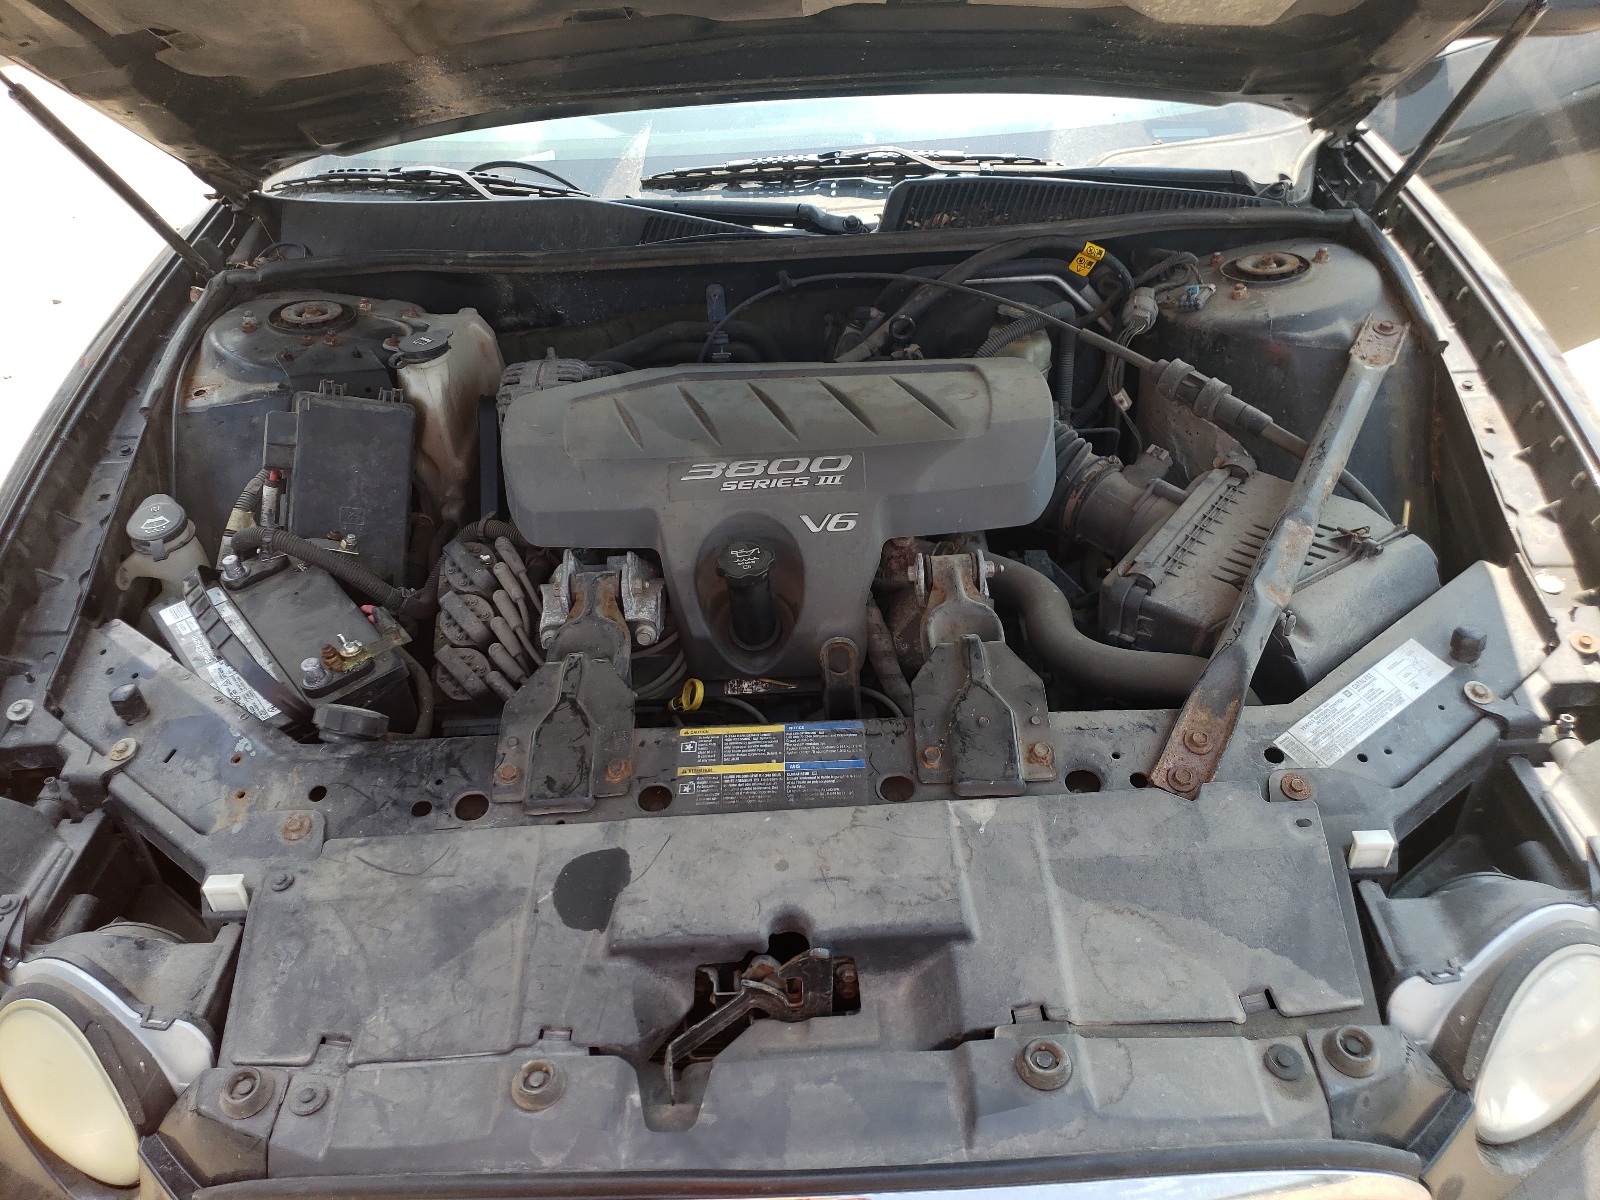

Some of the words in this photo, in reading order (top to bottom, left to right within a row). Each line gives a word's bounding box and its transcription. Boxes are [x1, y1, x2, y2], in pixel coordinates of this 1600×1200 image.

[680, 454, 853, 481] 3800
[719, 476, 810, 492] SERIES
[814, 474, 845, 487] III
[799, 512, 859, 533] V6
